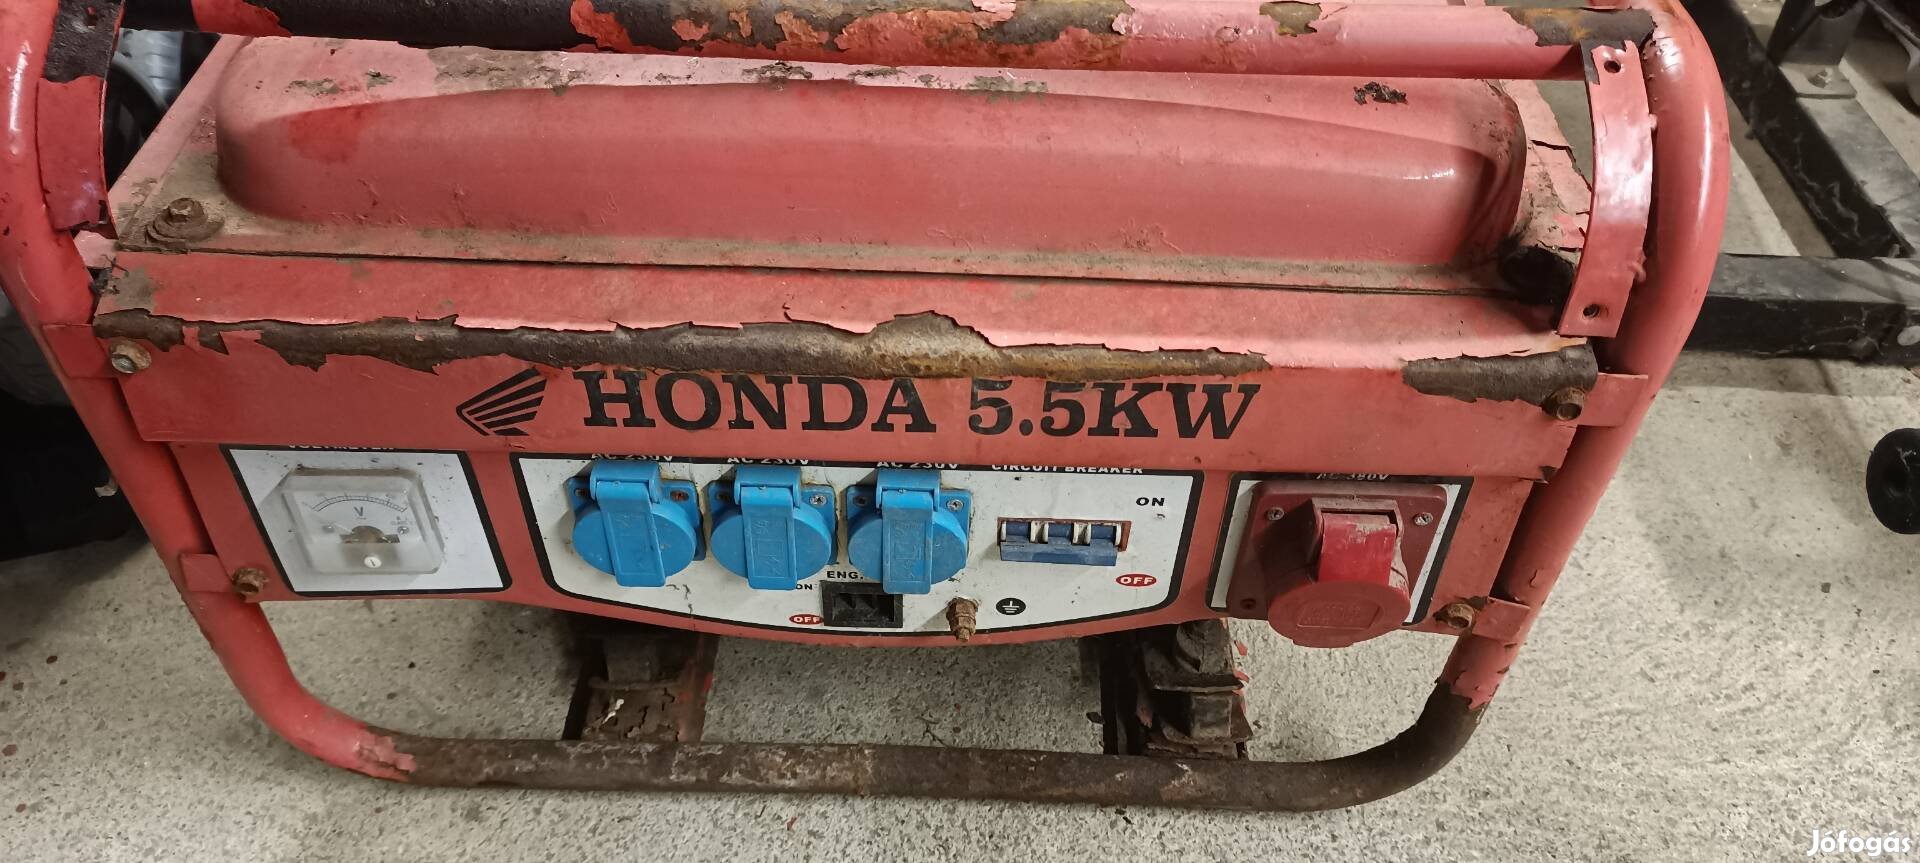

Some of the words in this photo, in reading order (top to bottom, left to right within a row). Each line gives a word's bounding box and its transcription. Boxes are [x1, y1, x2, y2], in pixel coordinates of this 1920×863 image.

[573, 370, 937, 432] HONDA
[968, 379, 1261, 439] 5.5KW
[1136, 497, 1165, 507] ON
[353, 506, 364, 517] V
[826, 570, 864, 580] ENG.
[1120, 576, 1154, 585] OFF
[796, 583, 813, 591] ON
